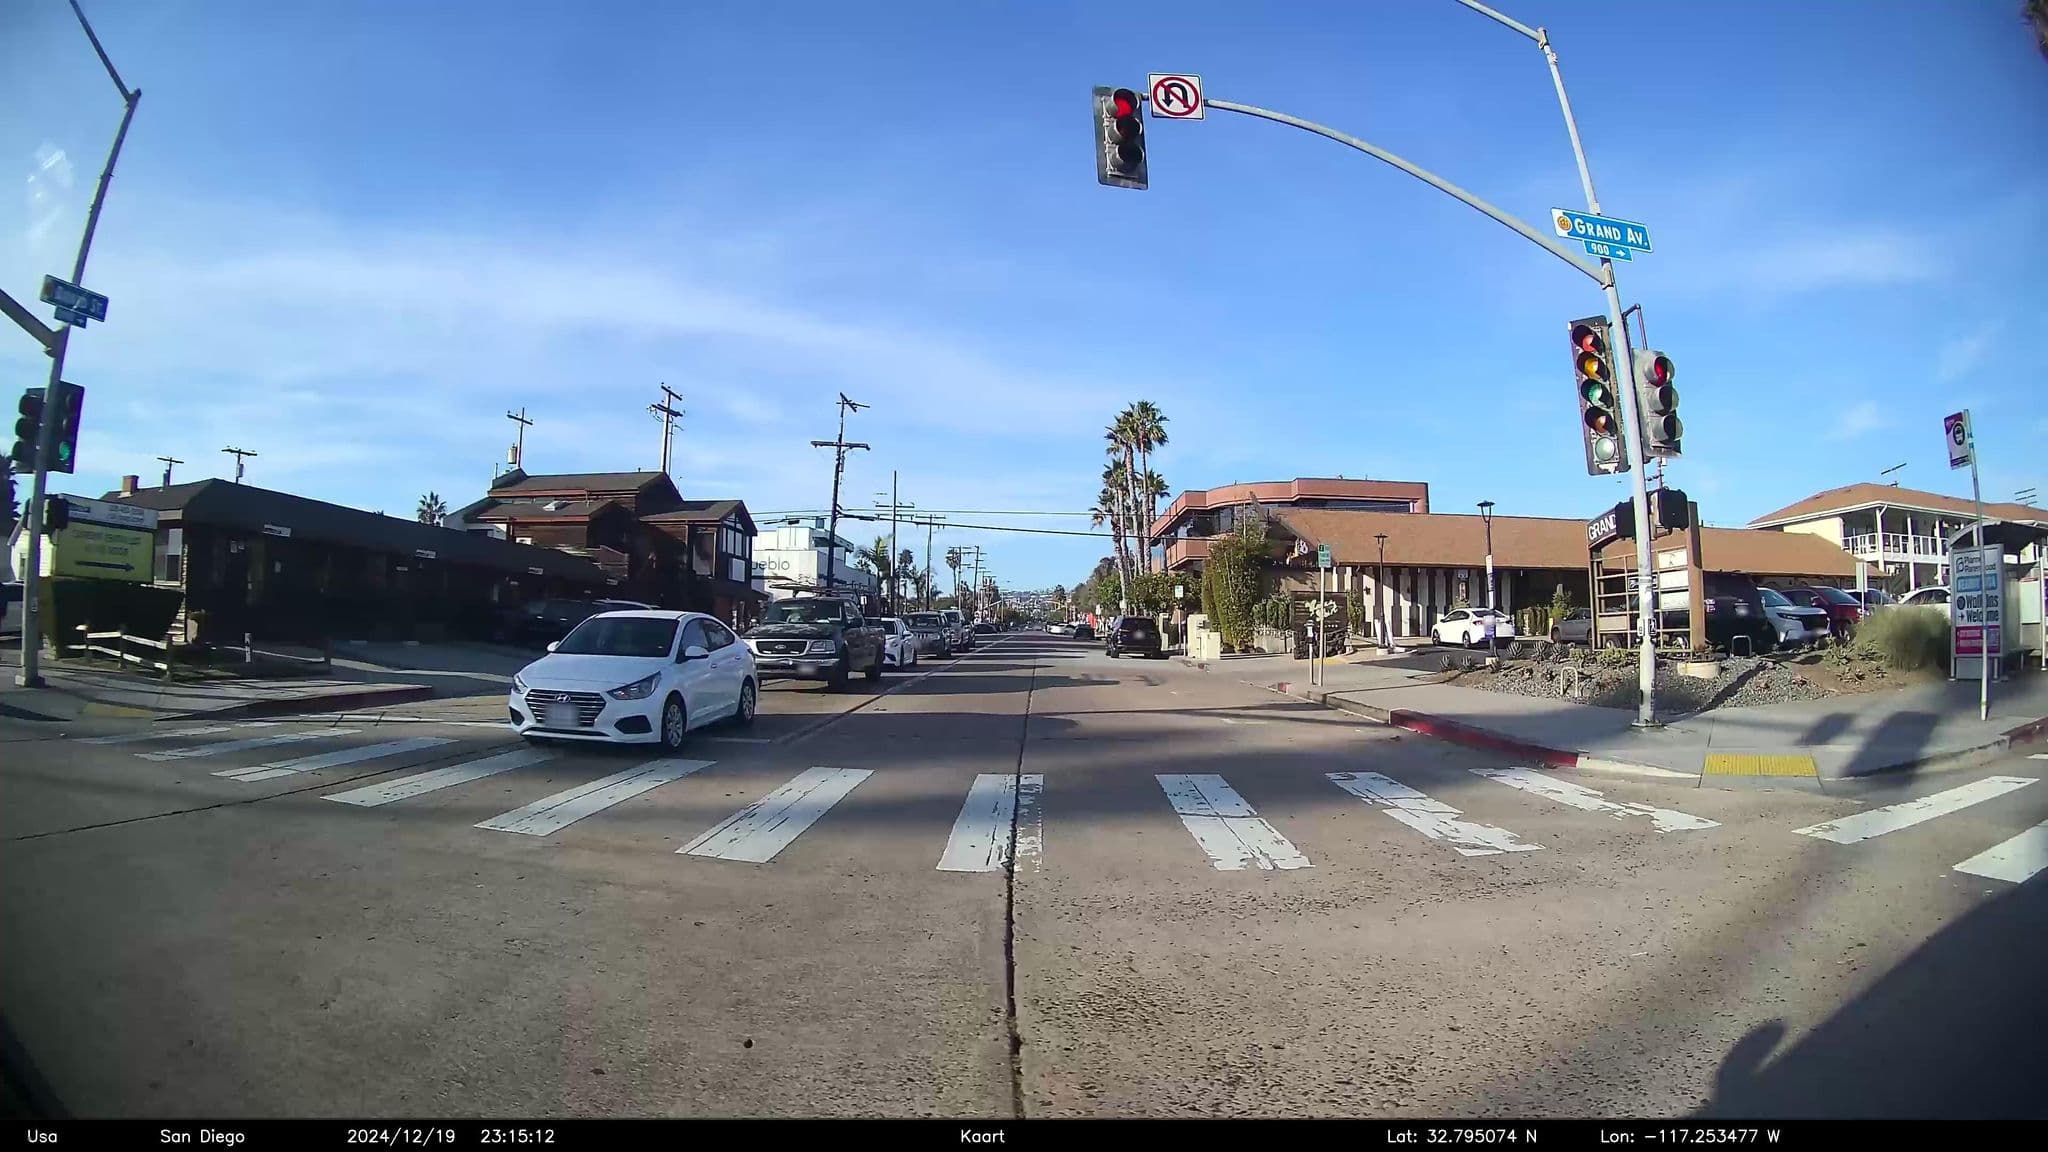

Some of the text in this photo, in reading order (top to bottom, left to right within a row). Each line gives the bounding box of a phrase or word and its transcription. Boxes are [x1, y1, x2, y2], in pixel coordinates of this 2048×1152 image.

[1591, 242, 1610, 256] 900
[1588, 513, 1617, 540] GRAND
[751, 555, 790, 571] ueblo
[1966, 609, 1999, 623] Welcme
